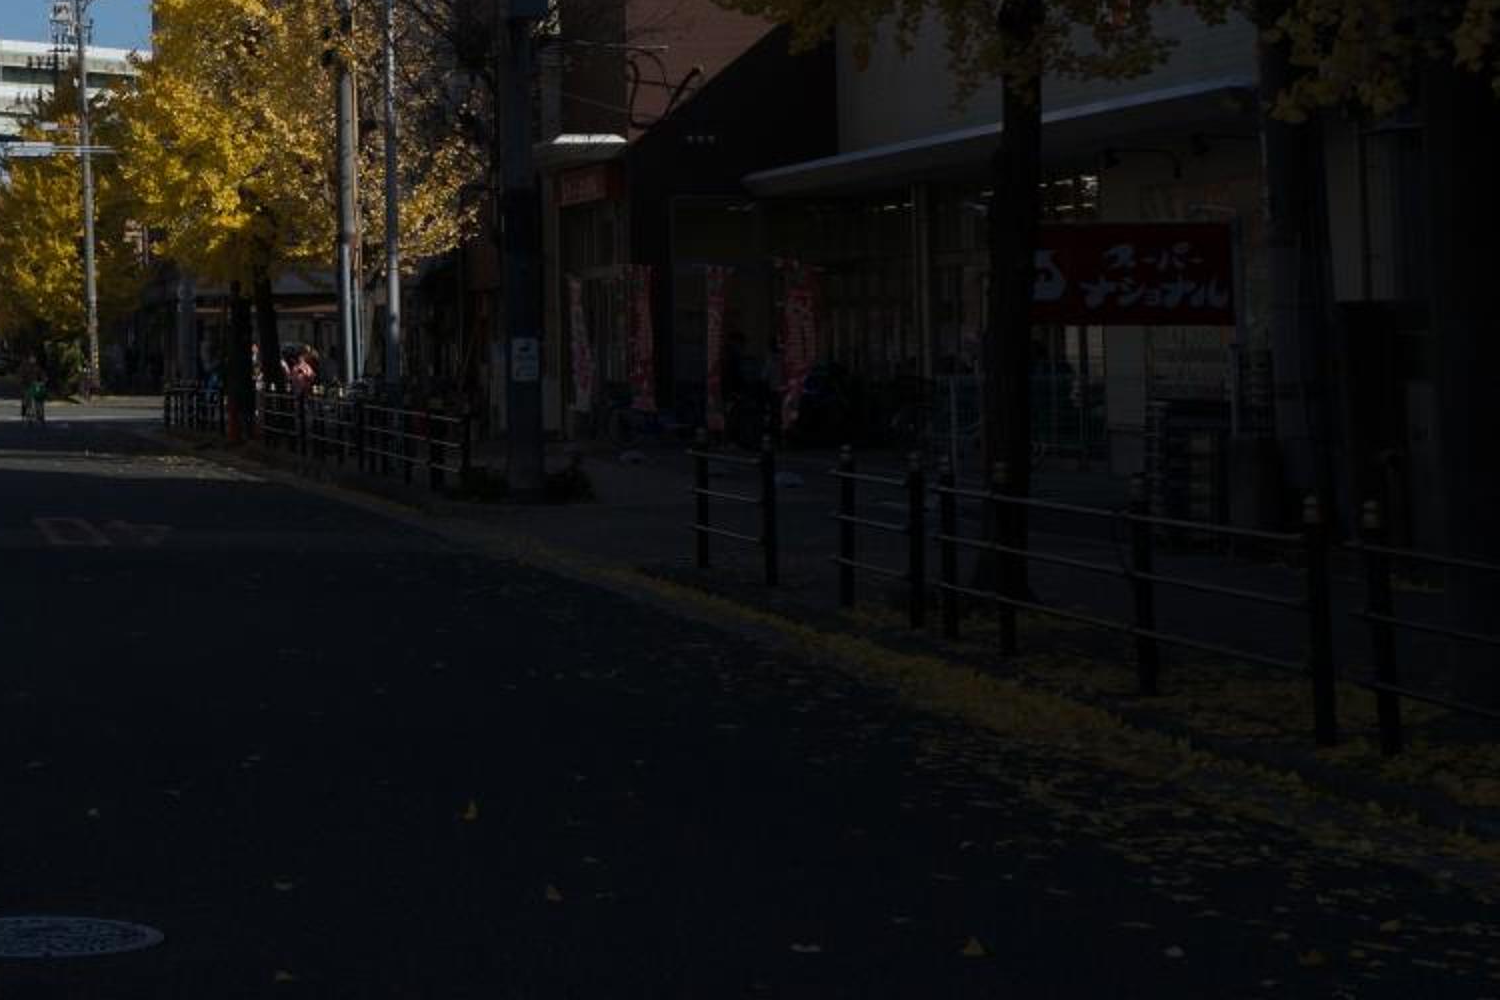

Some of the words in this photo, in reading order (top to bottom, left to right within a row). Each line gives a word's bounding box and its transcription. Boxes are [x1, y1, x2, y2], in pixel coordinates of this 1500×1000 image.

[1101, 241, 1205, 271] スーパー
[1077, 275, 1228, 312] ナショナル
